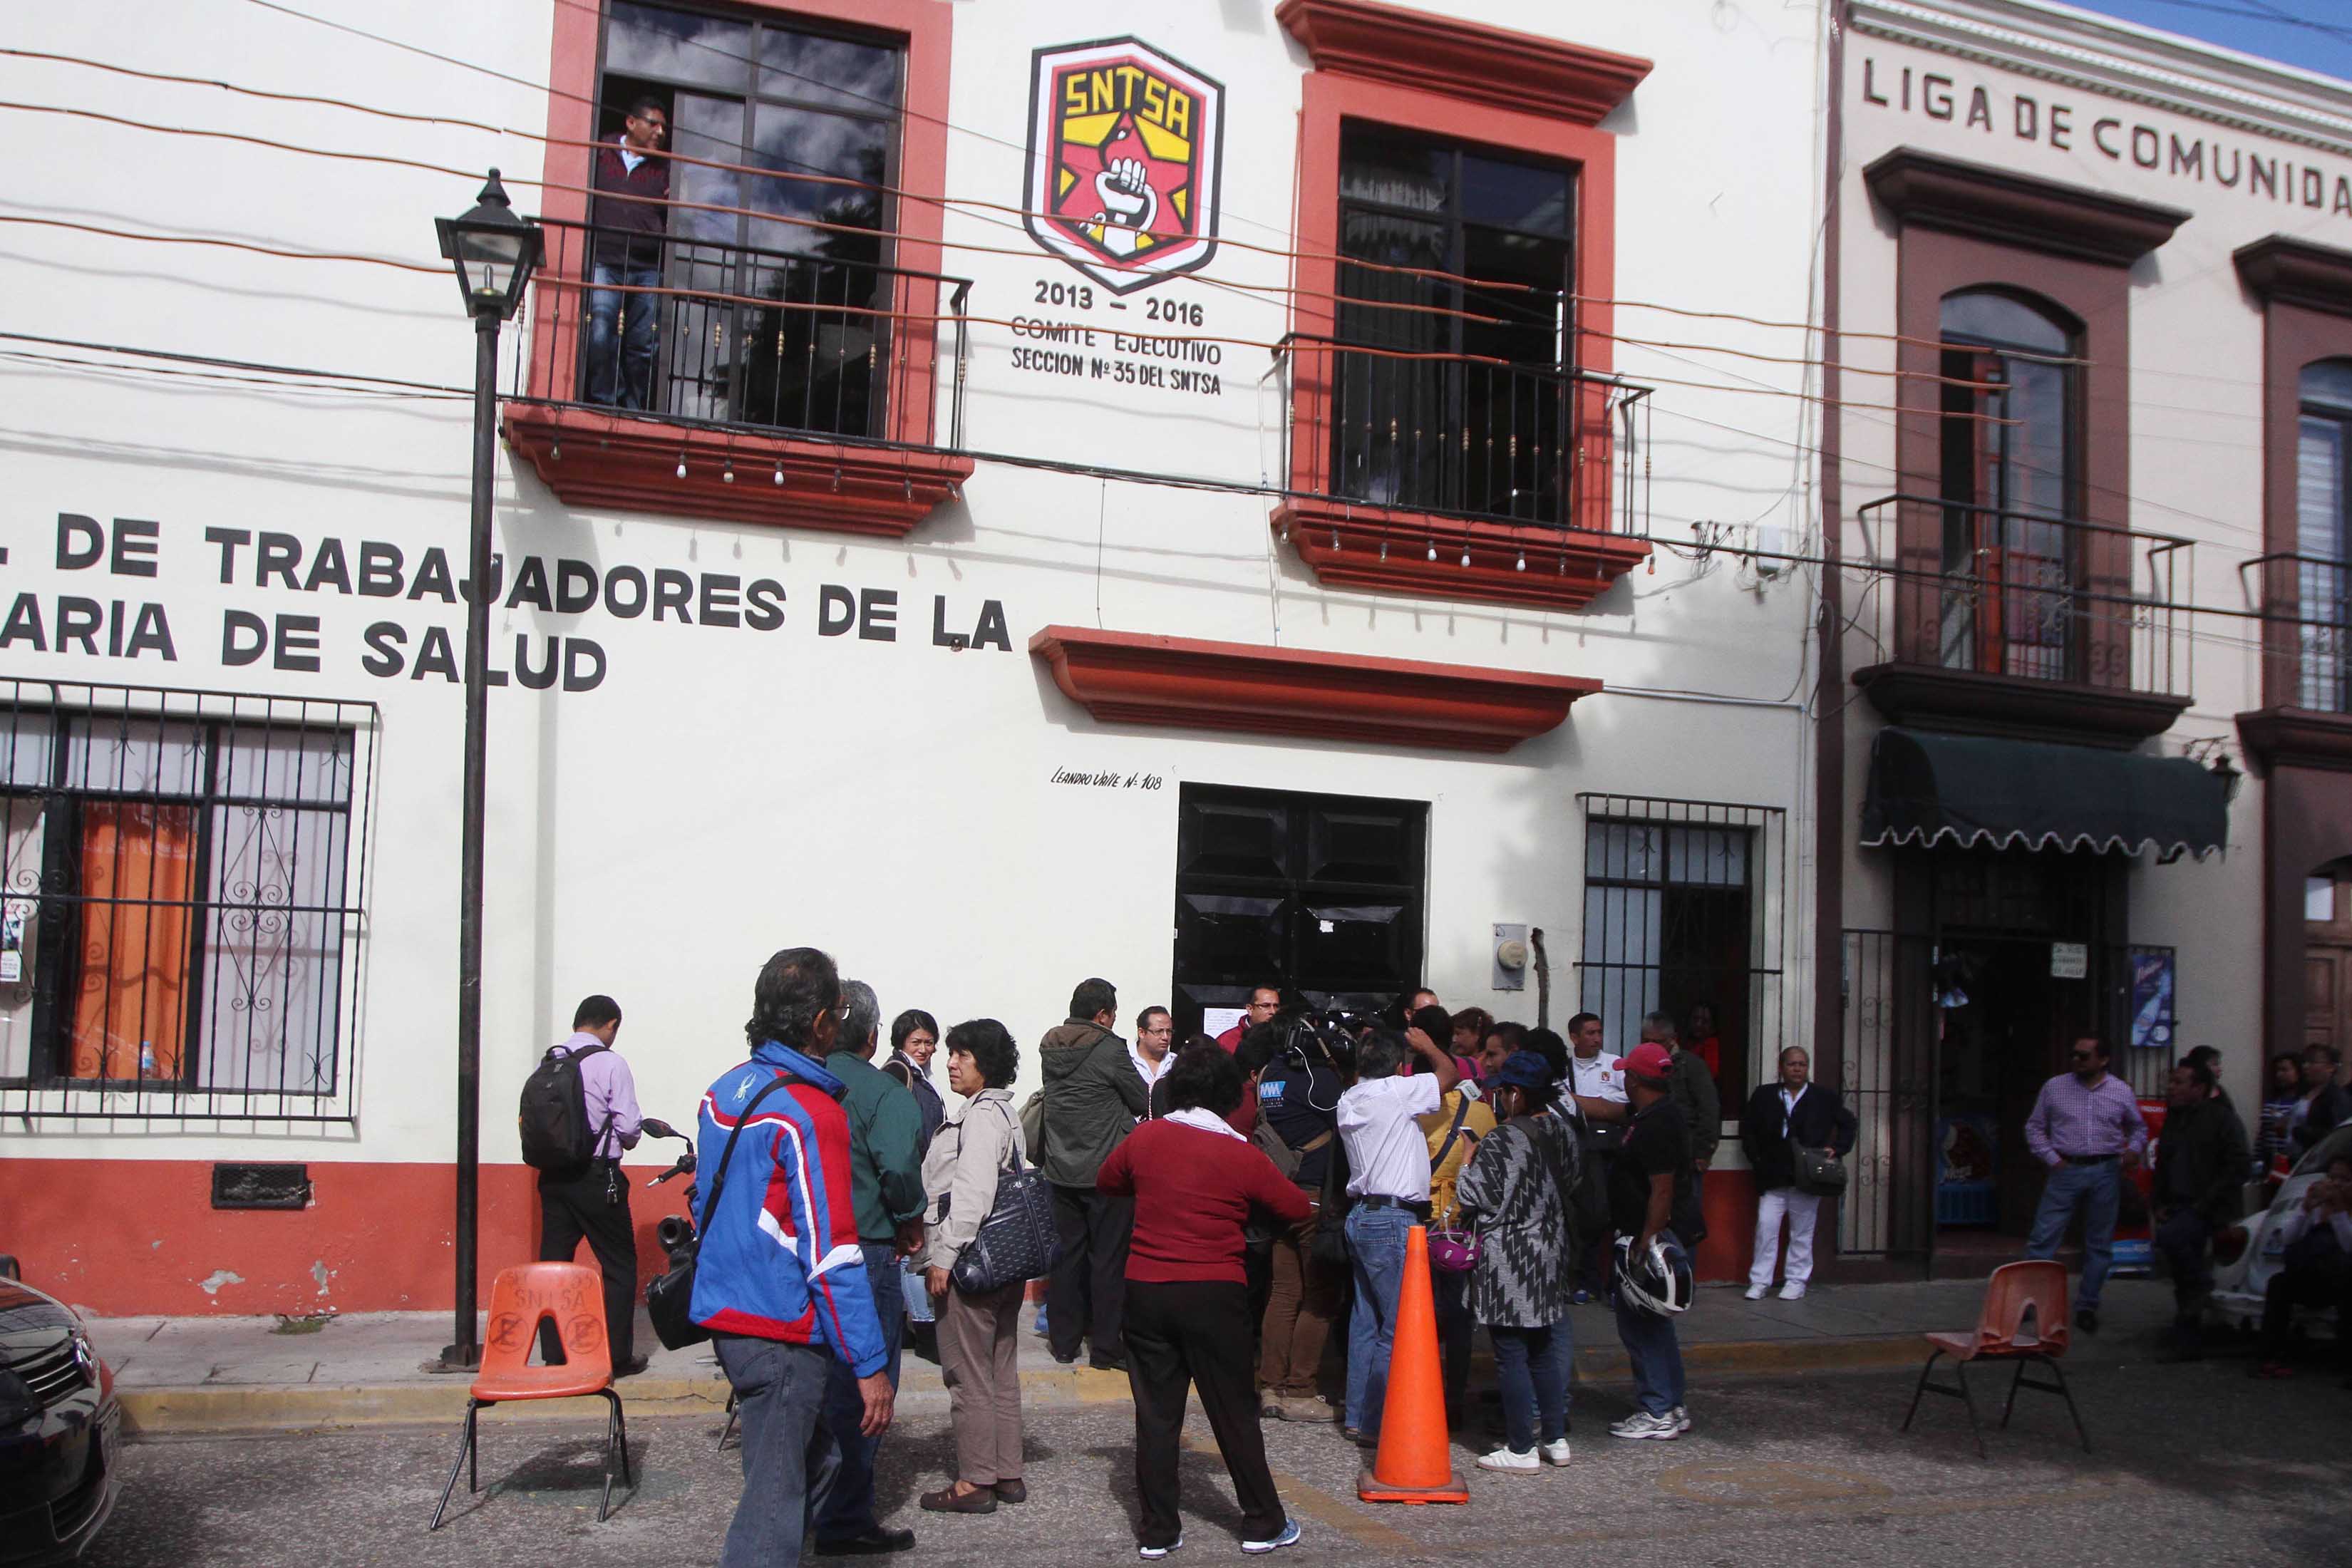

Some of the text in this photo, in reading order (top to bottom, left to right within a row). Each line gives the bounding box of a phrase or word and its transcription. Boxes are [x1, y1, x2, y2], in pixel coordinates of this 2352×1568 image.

[1066, 66, 1190, 139] SNTSA
[1862, 58, 1993, 133] LIGA
[2014, 93, 2073, 151] DE
[1034, 279, 1093, 309] 2013
[1146, 296, 1204, 326] 2016
[1011, 315, 1222, 364] COMITE EJECUTIVO
[1011, 346, 1083, 376] SECCION
[1113, 361, 1135, 383] 35
[1140, 364, 1166, 388] DEL
[1170, 369, 1221, 395] SNTSA
[56, 512, 160, 578] DE
[818, 583, 898, 641] DE
[932, 594, 1012, 651] LA
[0, 592, 178, 661] ARIA
[222, 609, 321, 673] DE
[1051, 765, 1093, 785] LEANDRO
[1140, 773, 1162, 790] 108
